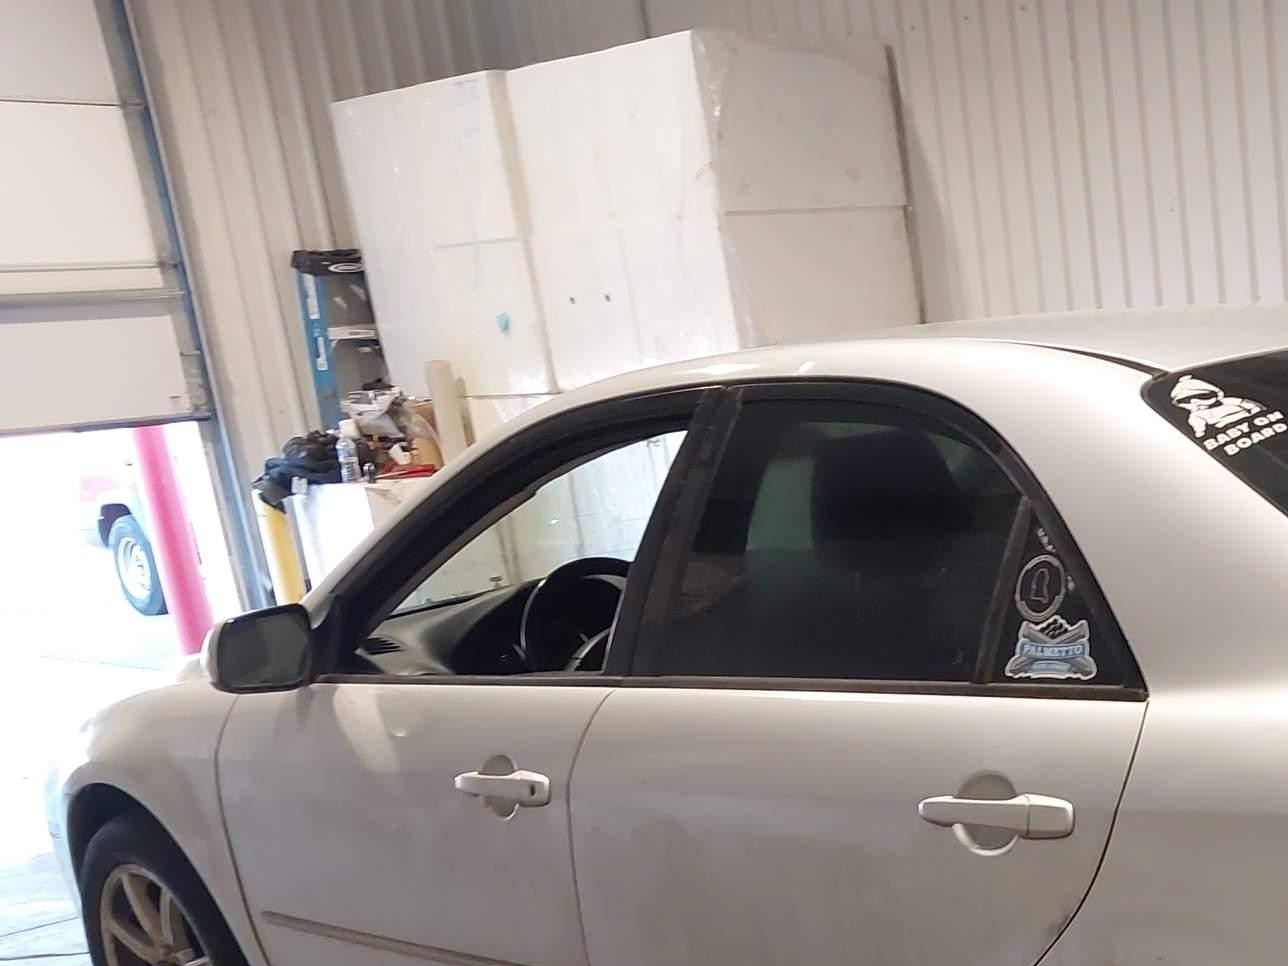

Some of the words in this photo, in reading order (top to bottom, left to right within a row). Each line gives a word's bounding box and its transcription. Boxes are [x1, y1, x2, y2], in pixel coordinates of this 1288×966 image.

[1203, 423, 1250, 451] BABY
[1253, 411, 1284, 426] ON
[1223, 423, 1288, 455] BOARD
